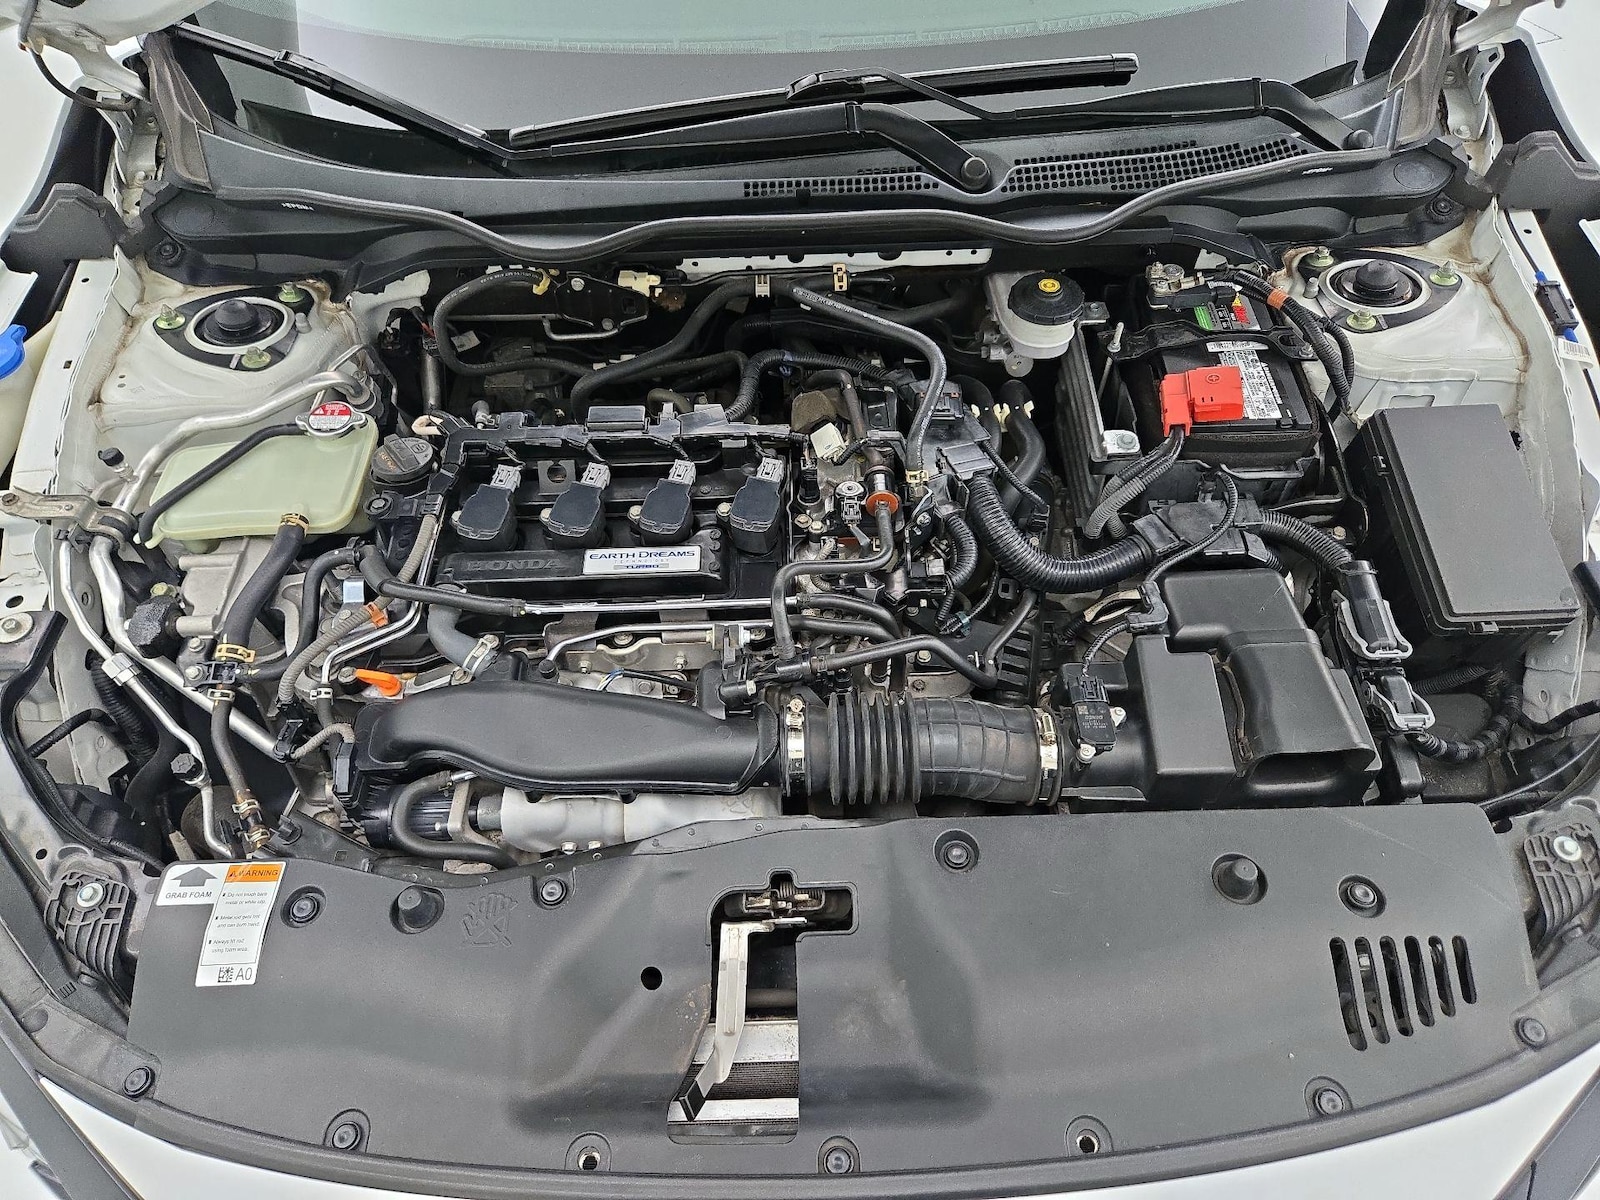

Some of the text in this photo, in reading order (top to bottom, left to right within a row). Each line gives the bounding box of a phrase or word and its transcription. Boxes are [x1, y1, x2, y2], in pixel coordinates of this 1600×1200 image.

[589, 550, 695, 560] EARTH DREAMS
[466, 558, 563, 572] HONDA
[239, 869, 278, 877] WARNING
[189, 891, 212, 899] FOAM
[235, 966, 253, 981] A0
